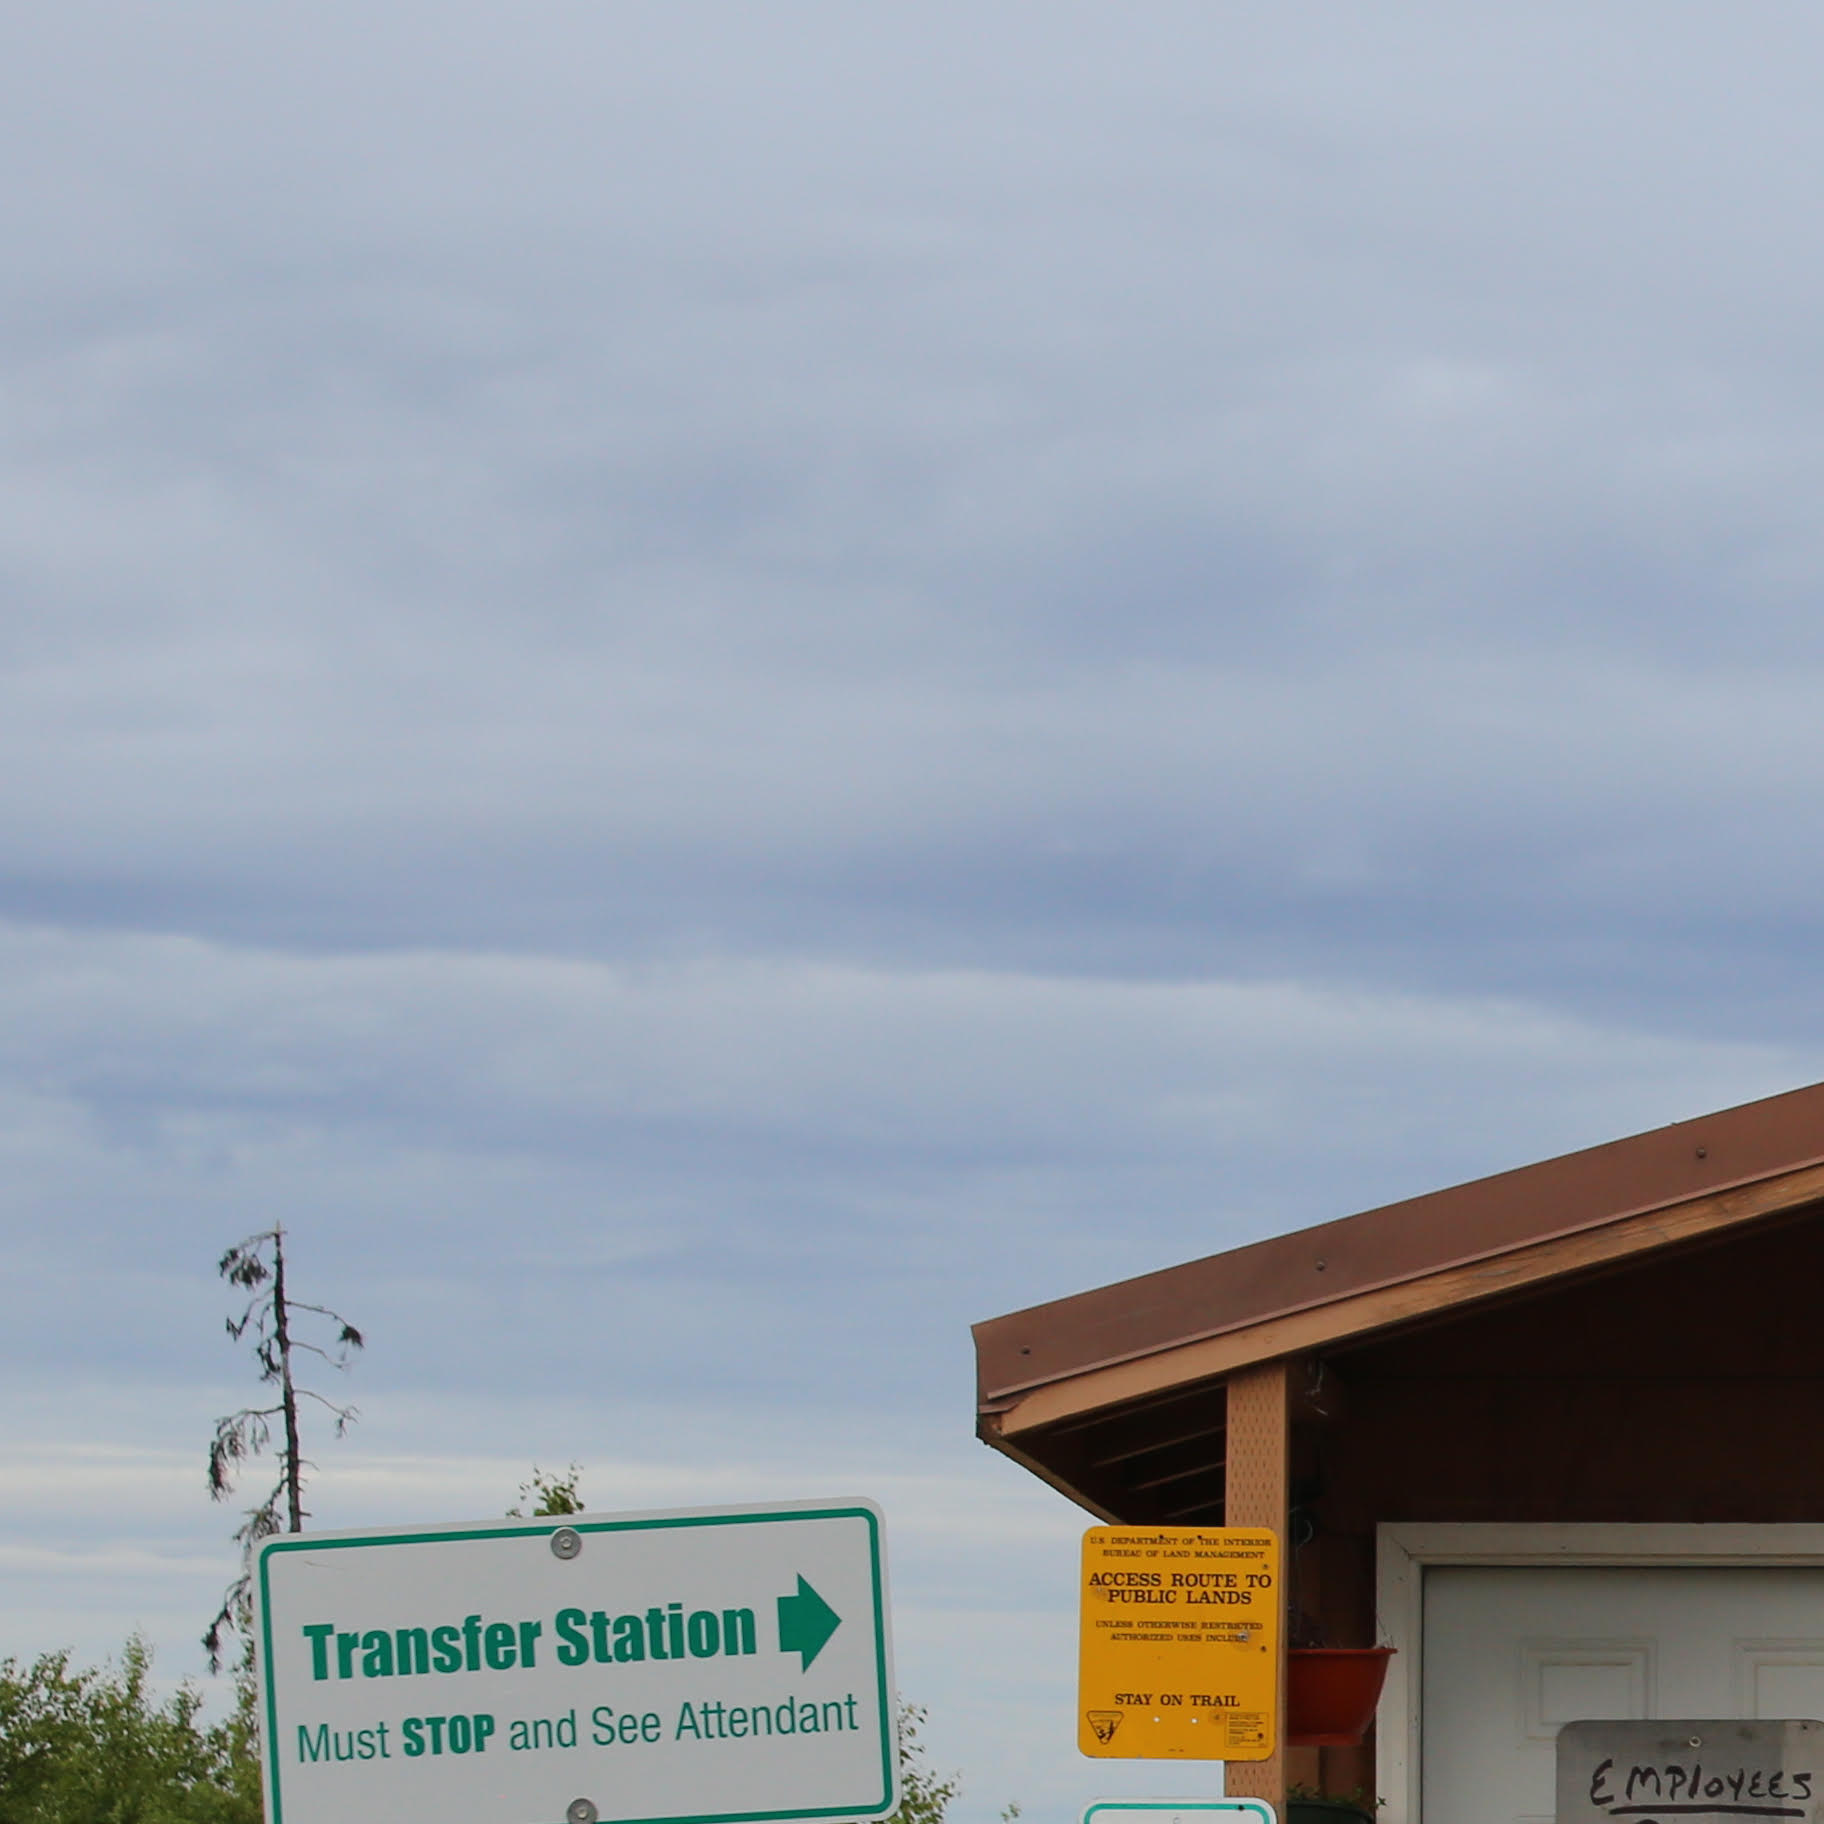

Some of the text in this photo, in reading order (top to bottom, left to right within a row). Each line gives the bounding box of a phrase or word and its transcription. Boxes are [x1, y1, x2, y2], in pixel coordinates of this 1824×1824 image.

[1089, 1573, 1272, 1588] ACCESS ROUTE TO
[1108, 1590, 1251, 1604] PUBLIC LANDS
[304, 1603, 757, 1680] Transfer Station
[1115, 1694, 1240, 1707] STAY ON TRAIL
[298, 1692, 859, 1762] Must STOP and See Attendant
